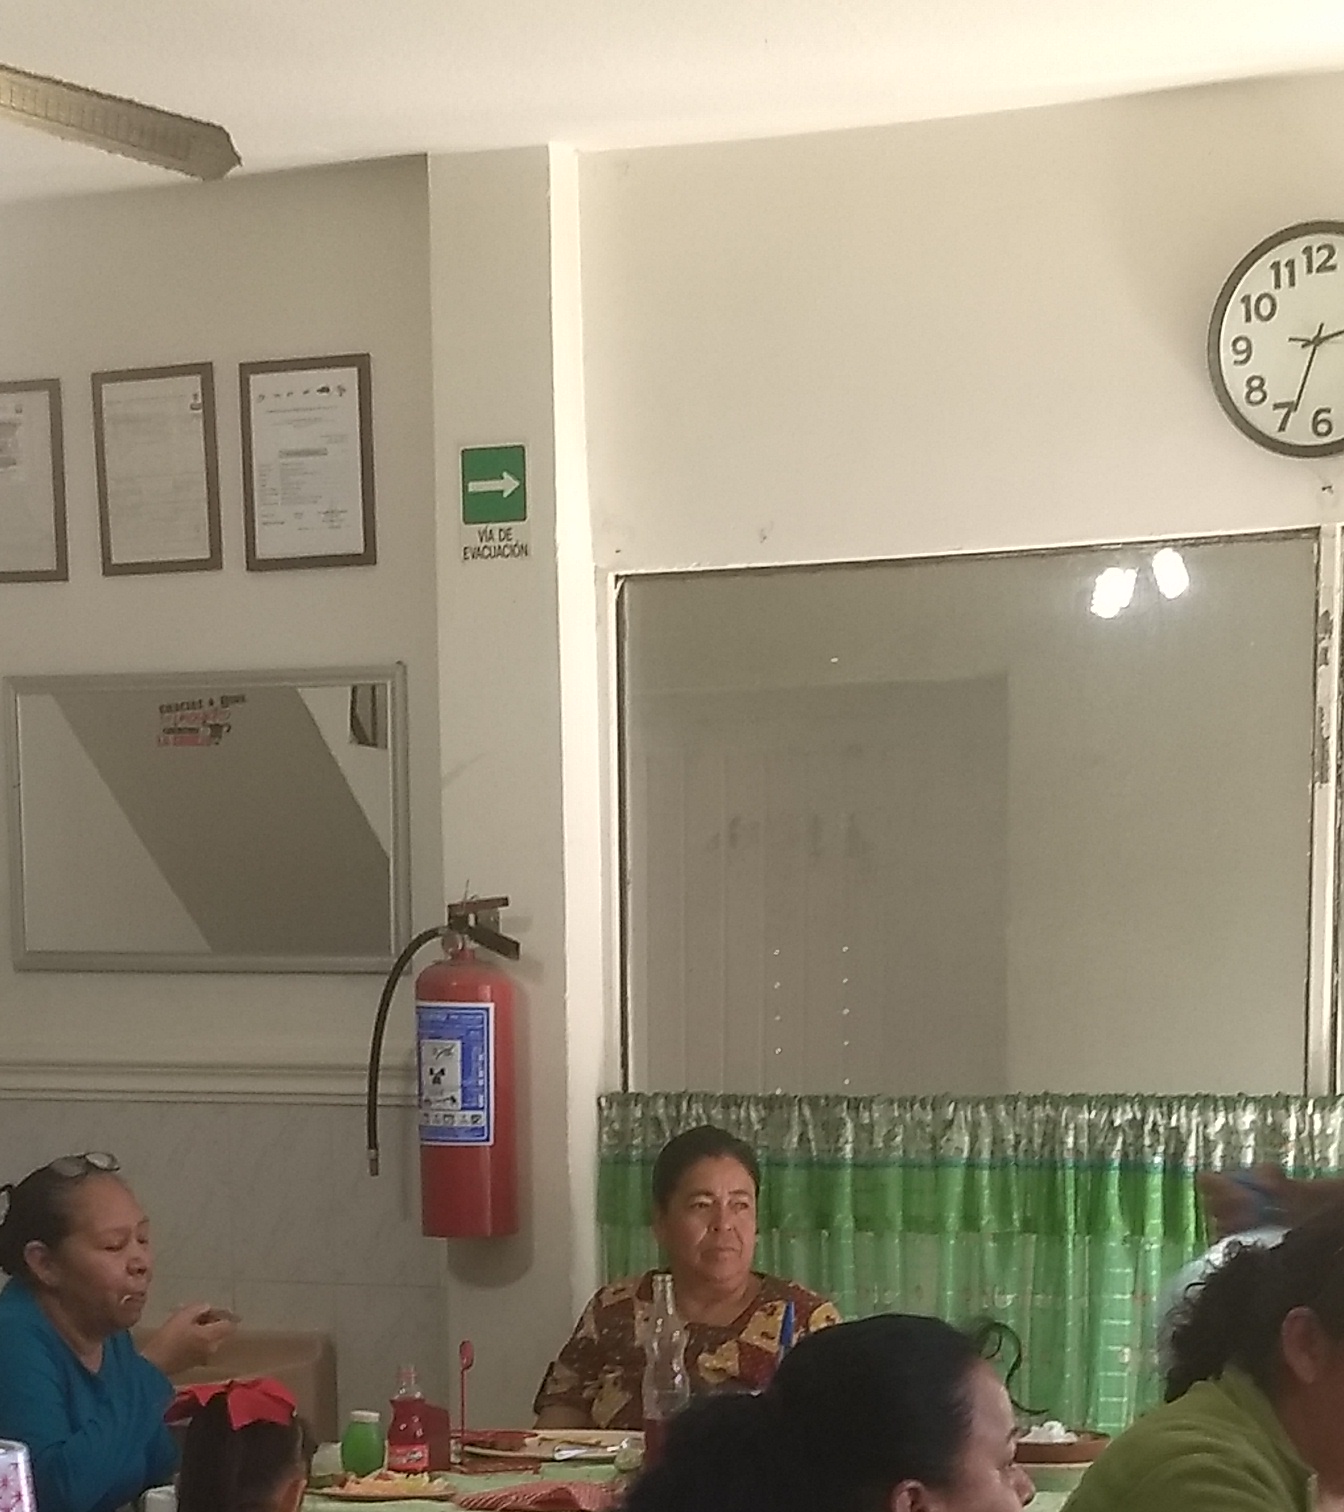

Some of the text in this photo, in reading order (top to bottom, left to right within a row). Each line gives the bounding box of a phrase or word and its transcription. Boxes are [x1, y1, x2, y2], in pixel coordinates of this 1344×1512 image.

[1269, 258, 1297, 290] 11
[1301, 242, 1338, 275] 12
[1239, 292, 1277, 323] 10
[1230, 335, 1253, 366] 9
[1244, 374, 1268, 407] 8
[1272, 400, 1296, 433] 7
[1311, 407, 1334, 438] 6
[498, 527, 513, 542] DE
[462, 540, 529, 561] EVACUACIÓN
